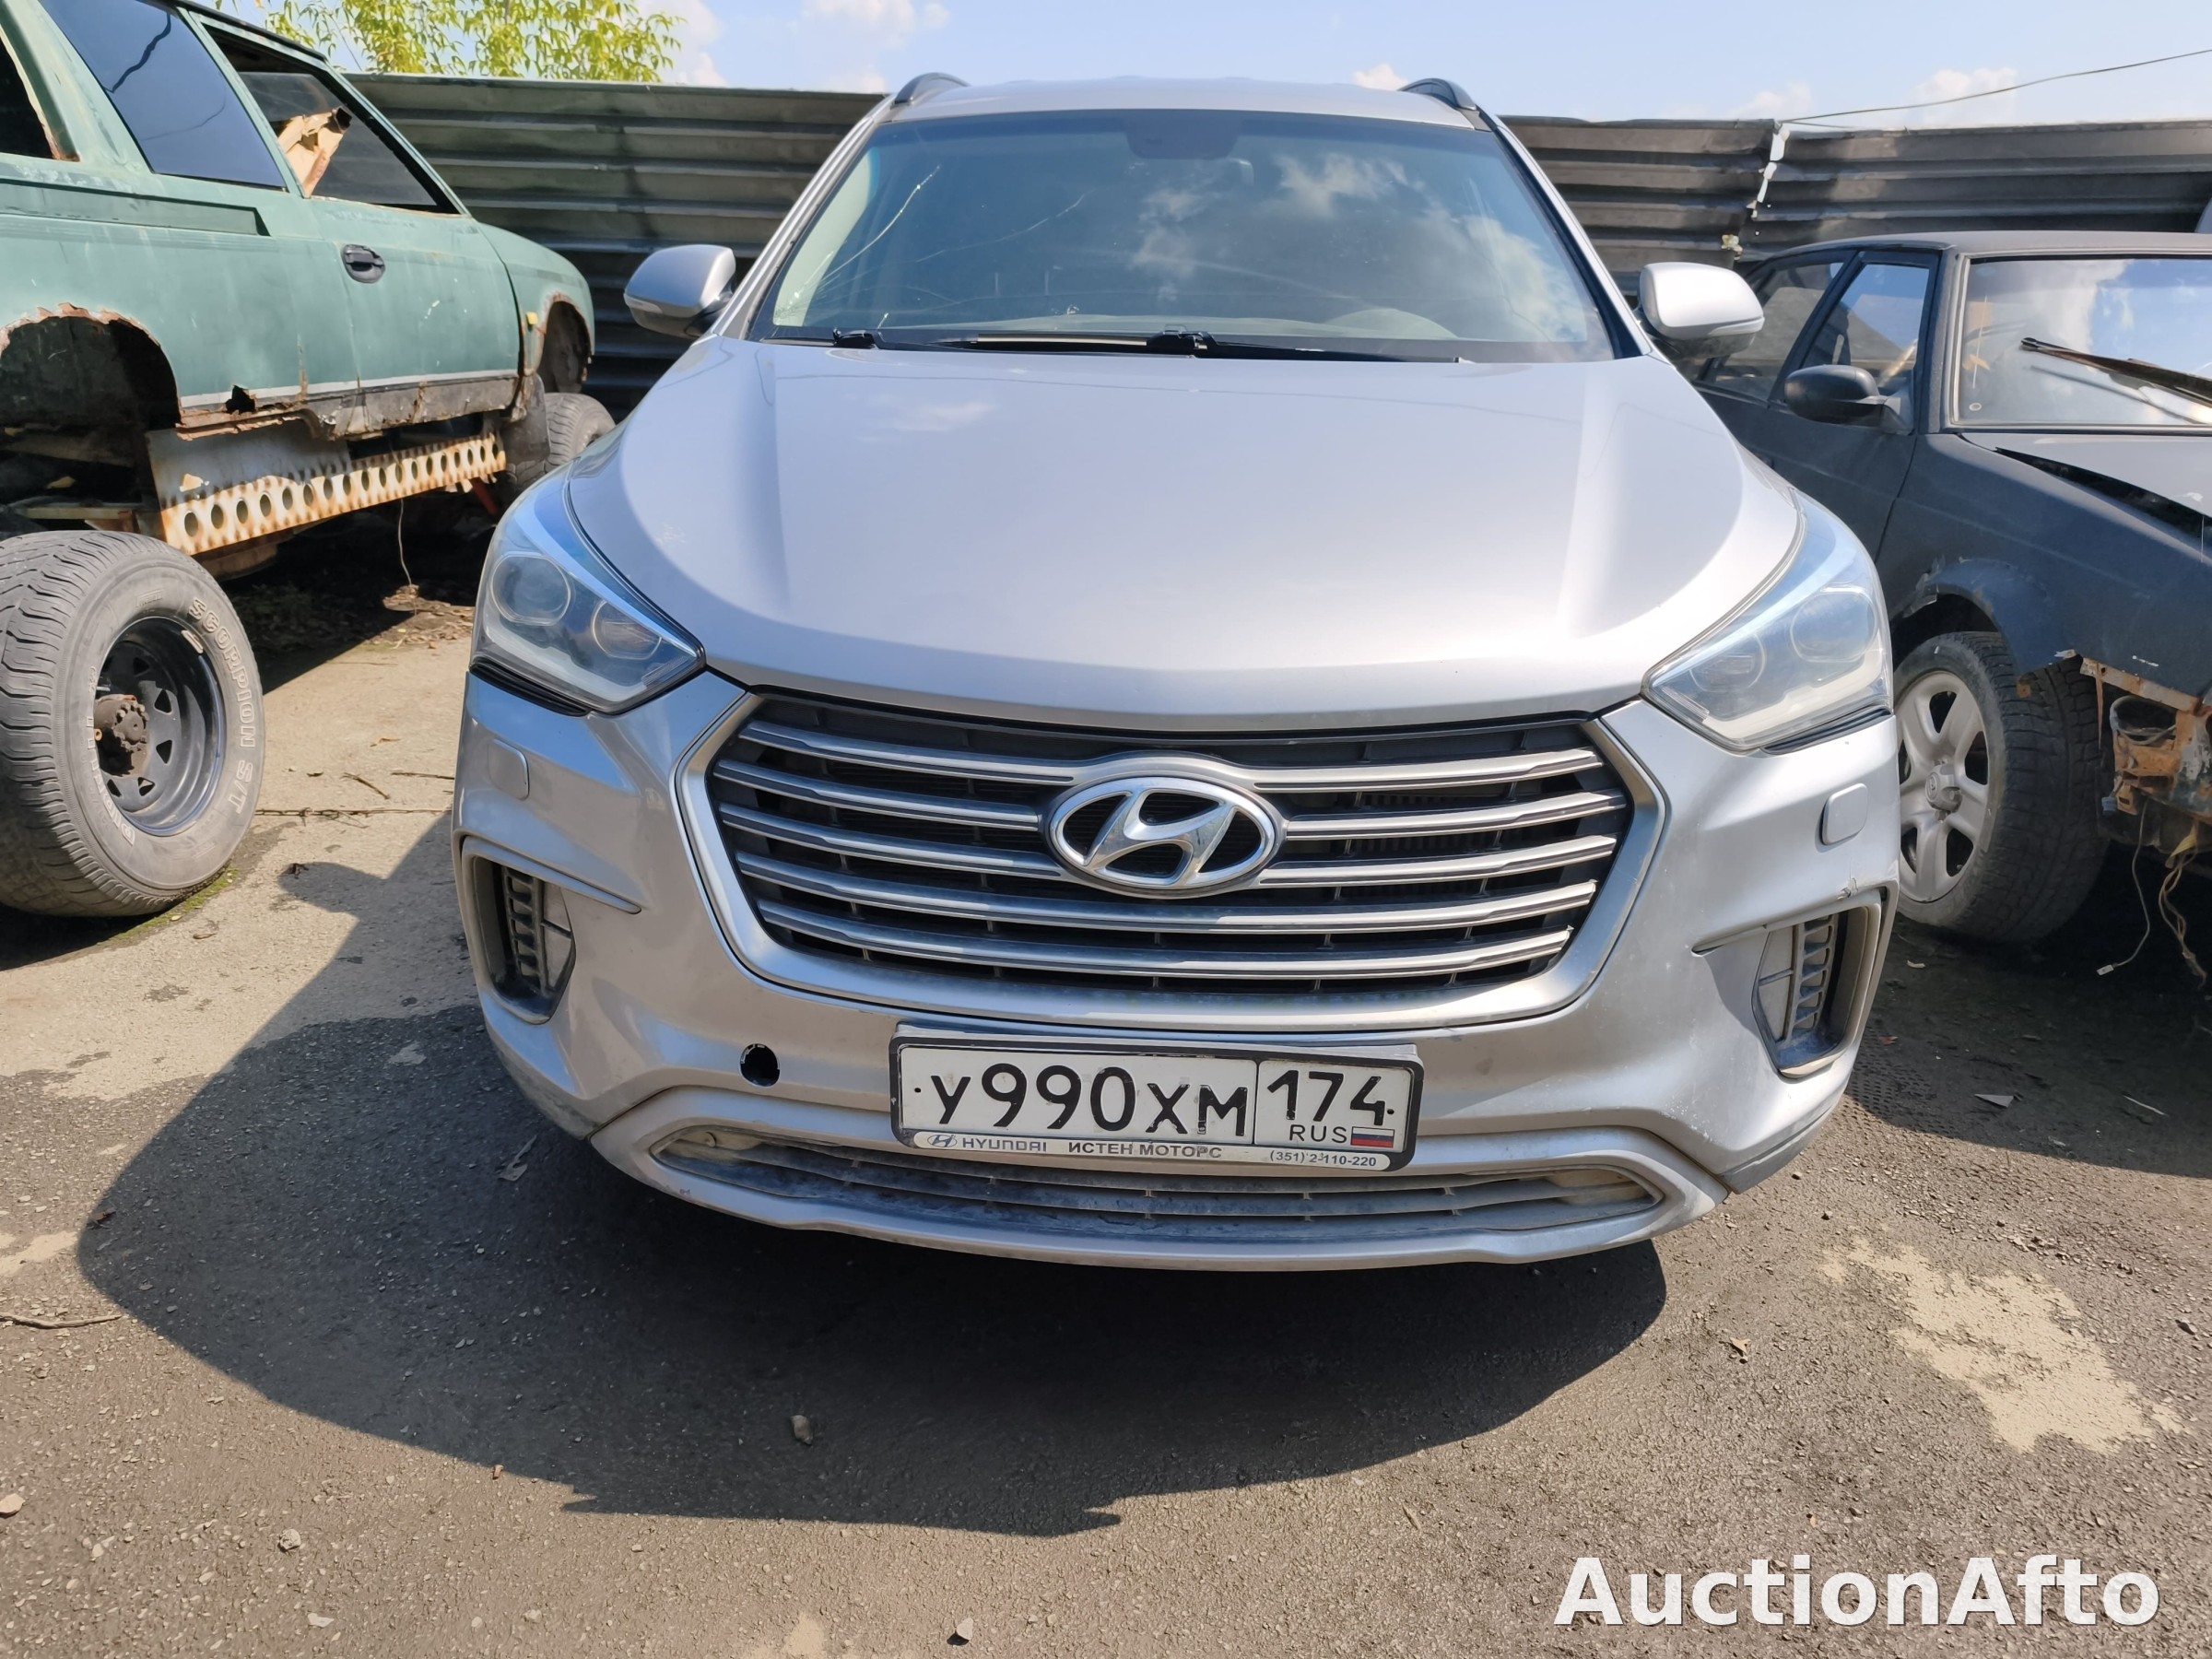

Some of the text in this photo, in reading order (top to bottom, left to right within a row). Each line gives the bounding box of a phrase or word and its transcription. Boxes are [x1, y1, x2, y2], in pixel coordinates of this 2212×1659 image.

[188, 597, 255, 748] SCORPION
[931, 1063, 1386, 1137] У990ХМ 174
[1288, 1124, 1348, 1144] RUS
[962, 1136, 1047, 1152] HYUNDAI
[1068, 1142, 1223, 1159] ИСТЕН МОТОРС
[1269, 1149, 1305, 1164] (351)
